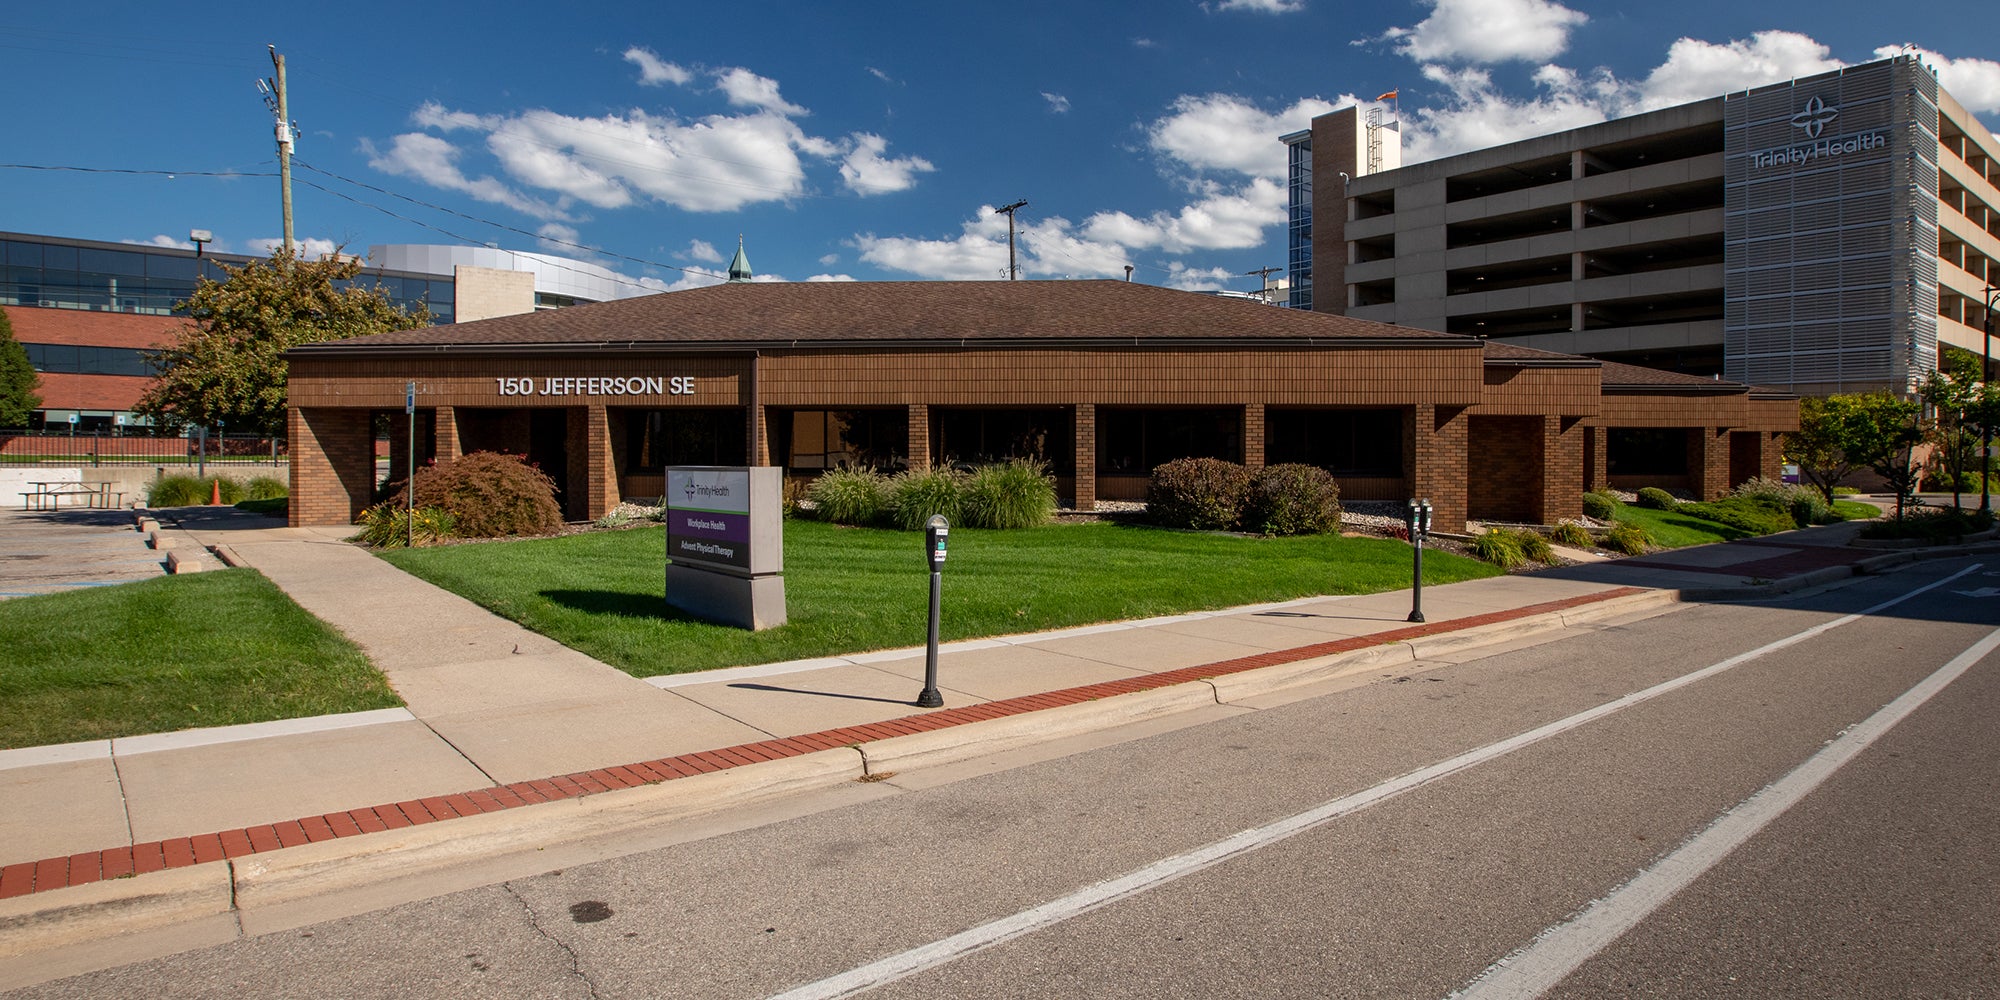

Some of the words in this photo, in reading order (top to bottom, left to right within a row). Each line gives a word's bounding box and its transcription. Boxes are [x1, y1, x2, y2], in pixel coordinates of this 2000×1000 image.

[1750, 147, 1811, 168] Trinity
[1814, 132, 1885, 158] Health
[496, 377, 534, 395] 150
[539, 377, 663, 395] JEFFERSON
[670, 377, 695, 395] SE
[696, 484, 711, 498] Trinity
[712, 485, 730, 496] Health
[687, 518, 710, 530] Workplace
[710, 520, 726, 530] Health
[681, 540, 696, 551] Advent
[696, 542, 714, 554] Physical
[714, 544, 734, 558] Therapy
